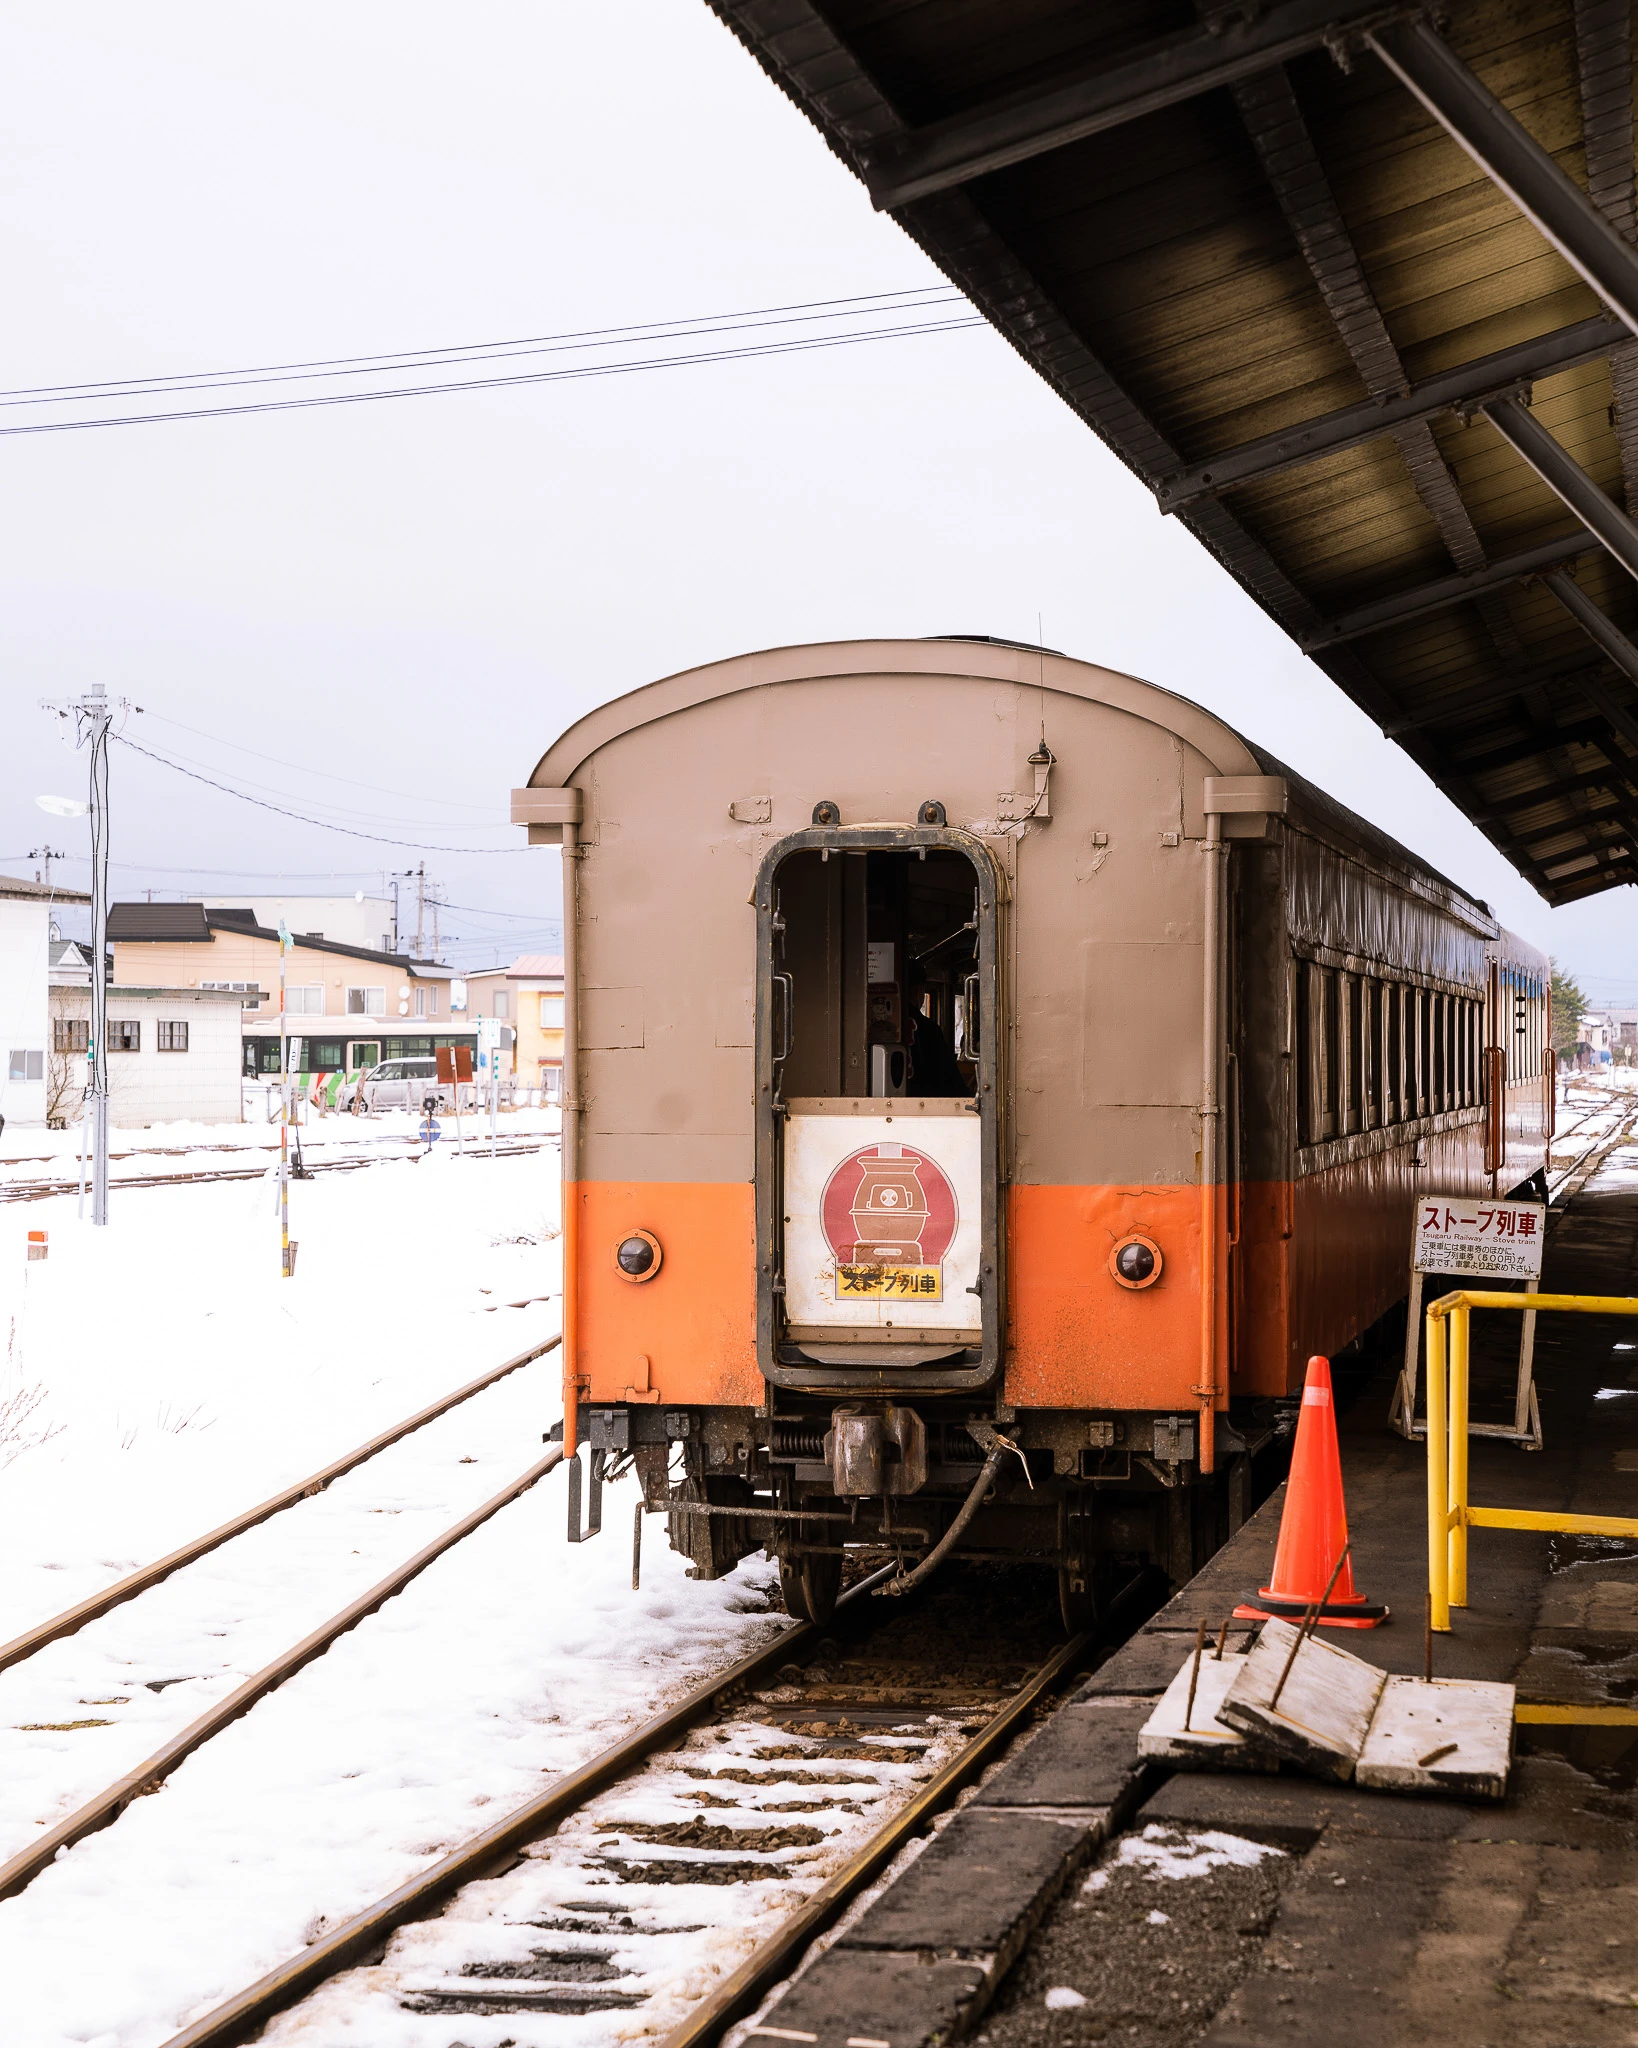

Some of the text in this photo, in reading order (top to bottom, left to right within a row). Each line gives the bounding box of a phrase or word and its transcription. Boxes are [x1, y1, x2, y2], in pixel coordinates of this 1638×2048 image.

[1423, 1207, 1537, 1237] ストーブ列車
[1454, 1233, 1483, 1242] Railway
[843, 1271, 936, 1293] ストーブ列車
